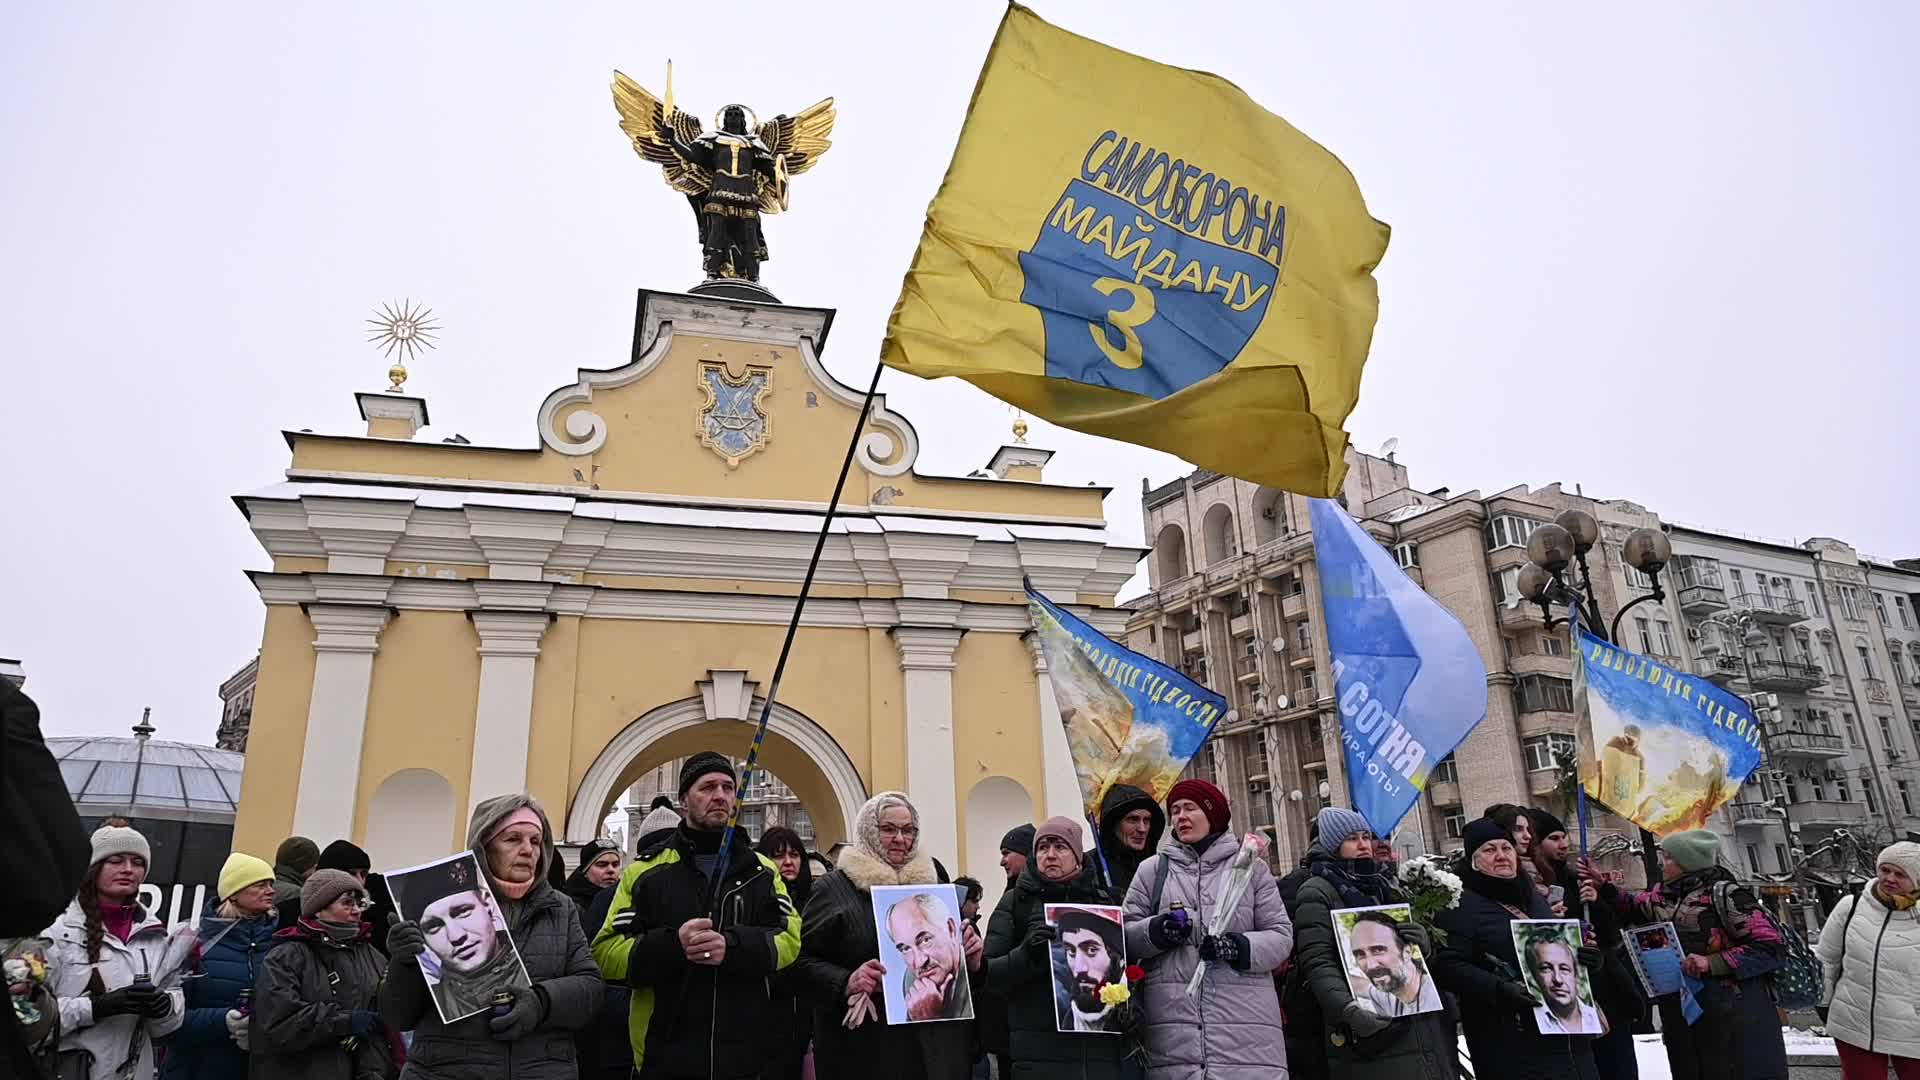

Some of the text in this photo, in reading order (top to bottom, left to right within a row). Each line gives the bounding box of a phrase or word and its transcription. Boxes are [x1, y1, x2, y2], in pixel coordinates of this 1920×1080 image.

[1081, 130, 1286, 265] САМООБОРОНА
[1050, 197, 1269, 312] МАЙДАНУ
[1590, 645, 1693, 701] РЕВОЛЮЦІЯ
[1339, 681, 1427, 780] СОТНЯ
